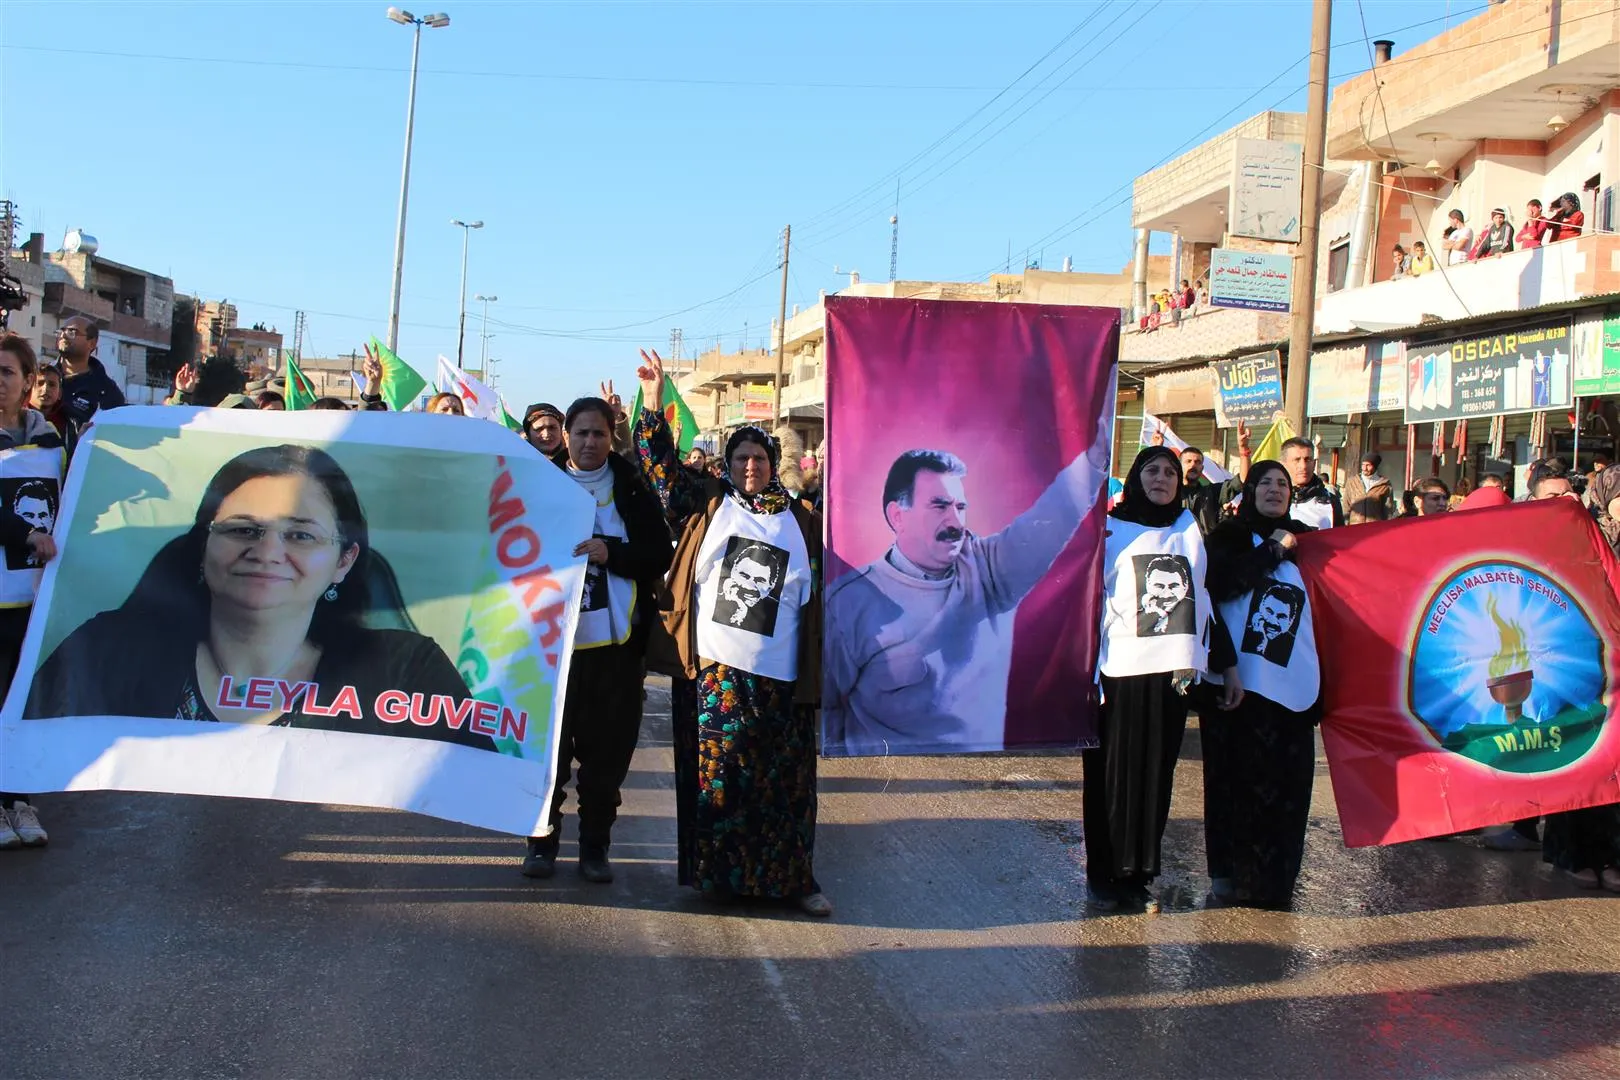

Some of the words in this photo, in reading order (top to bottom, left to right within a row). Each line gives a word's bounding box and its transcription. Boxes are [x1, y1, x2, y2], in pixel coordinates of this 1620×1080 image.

[1241, 255, 1265, 265] الدكتور
[1452, 334, 1518, 363] OSCAR
[1455, 365, 1480, 387] الفجر
[1480, 363, 1501, 383] مركز
[1462, 389, 1470, 399] TEL
[1485, 386, 1496, 396] 654
[1463, 571, 1525, 590] MALBATÊN
[216, 676, 363, 720] LEYLA
[374, 689, 529, 743] GUVEN
[1493, 725, 1562, 753] M.M.Ş
